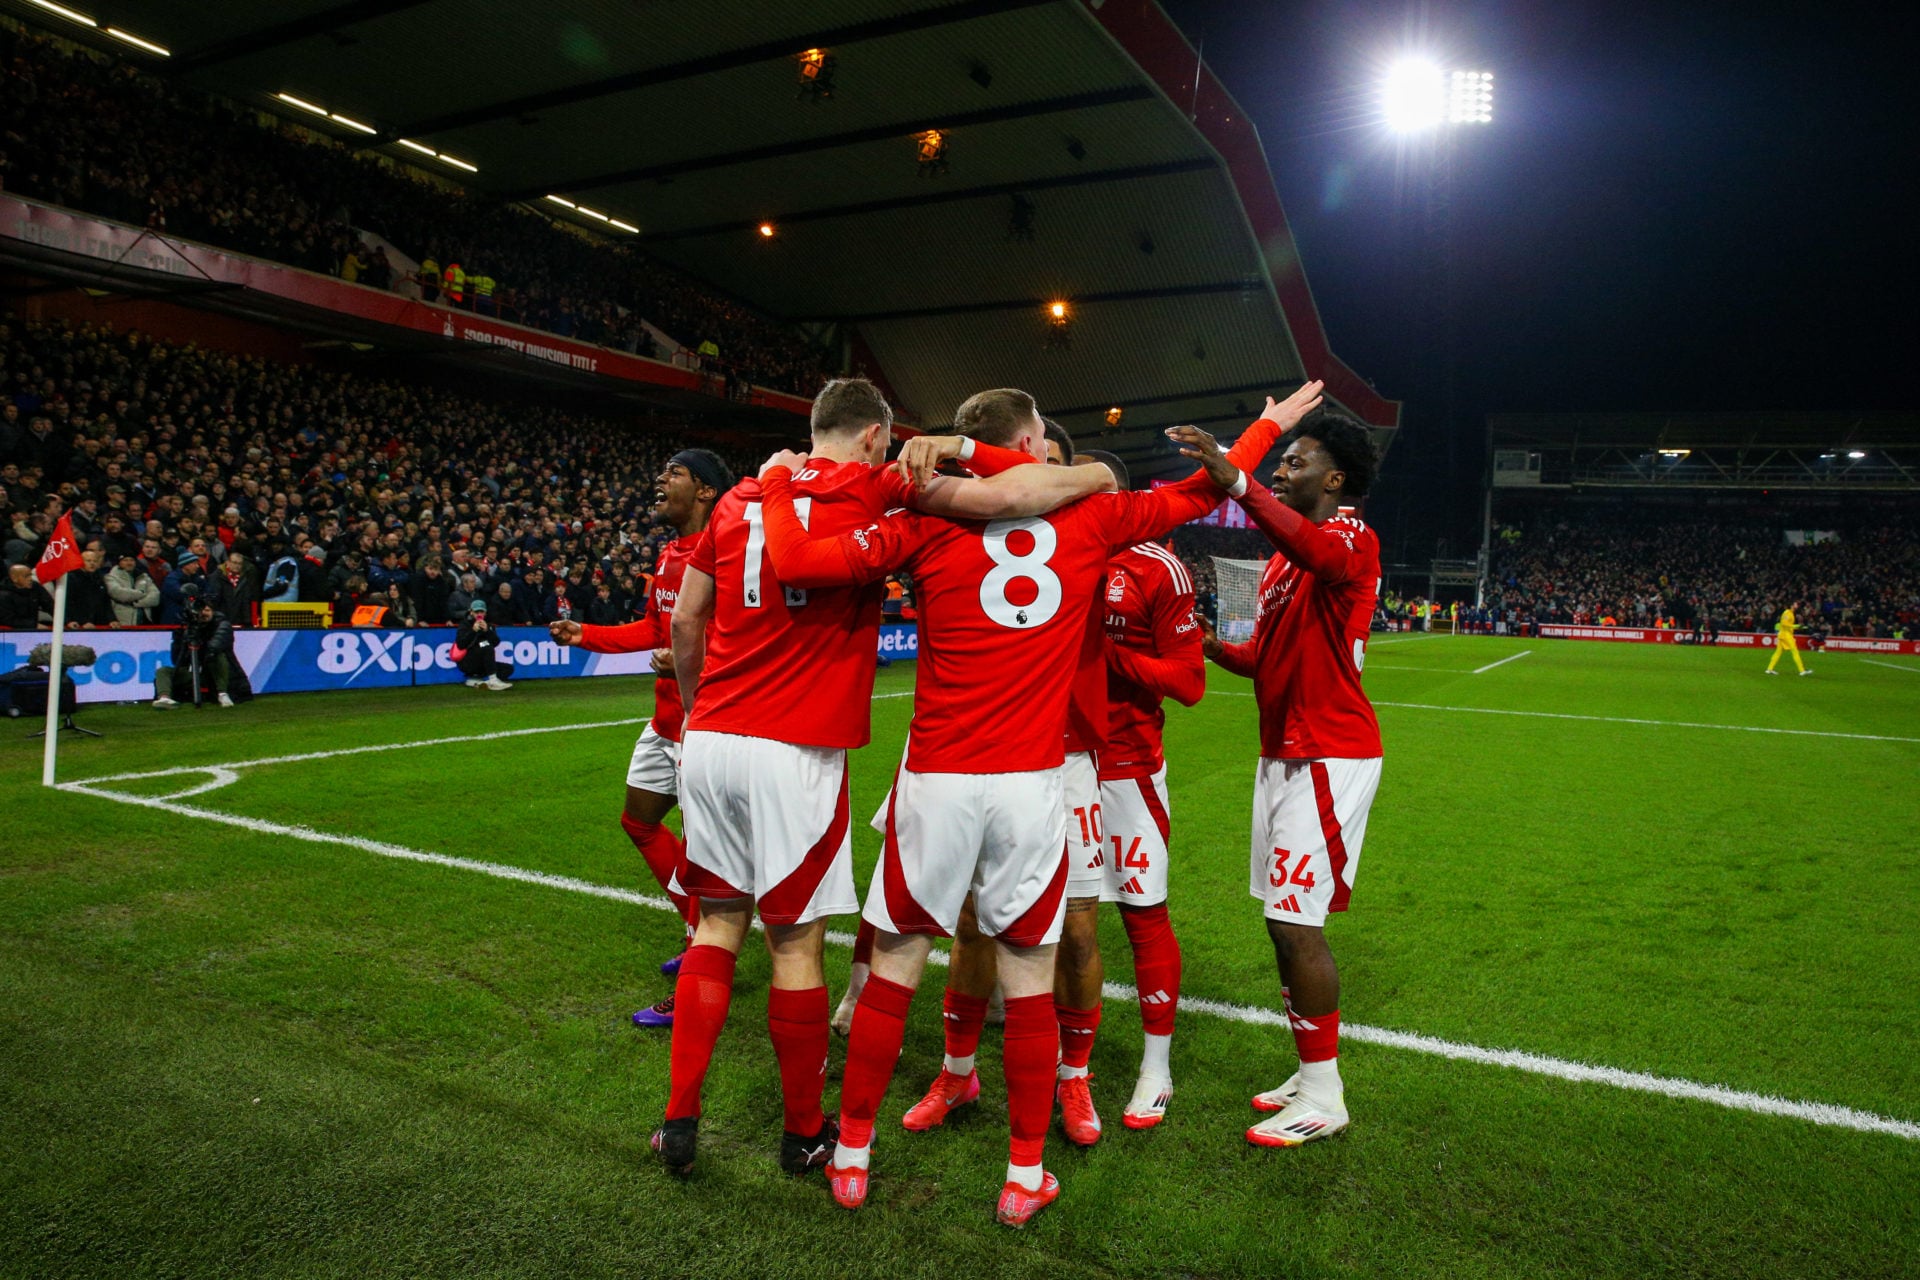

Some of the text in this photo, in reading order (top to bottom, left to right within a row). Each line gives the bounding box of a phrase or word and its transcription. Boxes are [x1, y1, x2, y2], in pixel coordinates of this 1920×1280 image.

[494, 335, 525, 353] FIRST
[526, 344, 571, 366] DIVISION
[571, 354, 598, 372] TITLE
[980, 516, 1062, 629] 8
[1541, 628, 1563, 636] FOLLOW
[1594, 630, 1613, 638] SOCIAL
[1614, 631, 1645, 639] CHANNELS
[1073, 803, 1103, 847] 10
[1110, 835, 1149, 874] 14
[1270, 847, 1316, 894] 34
